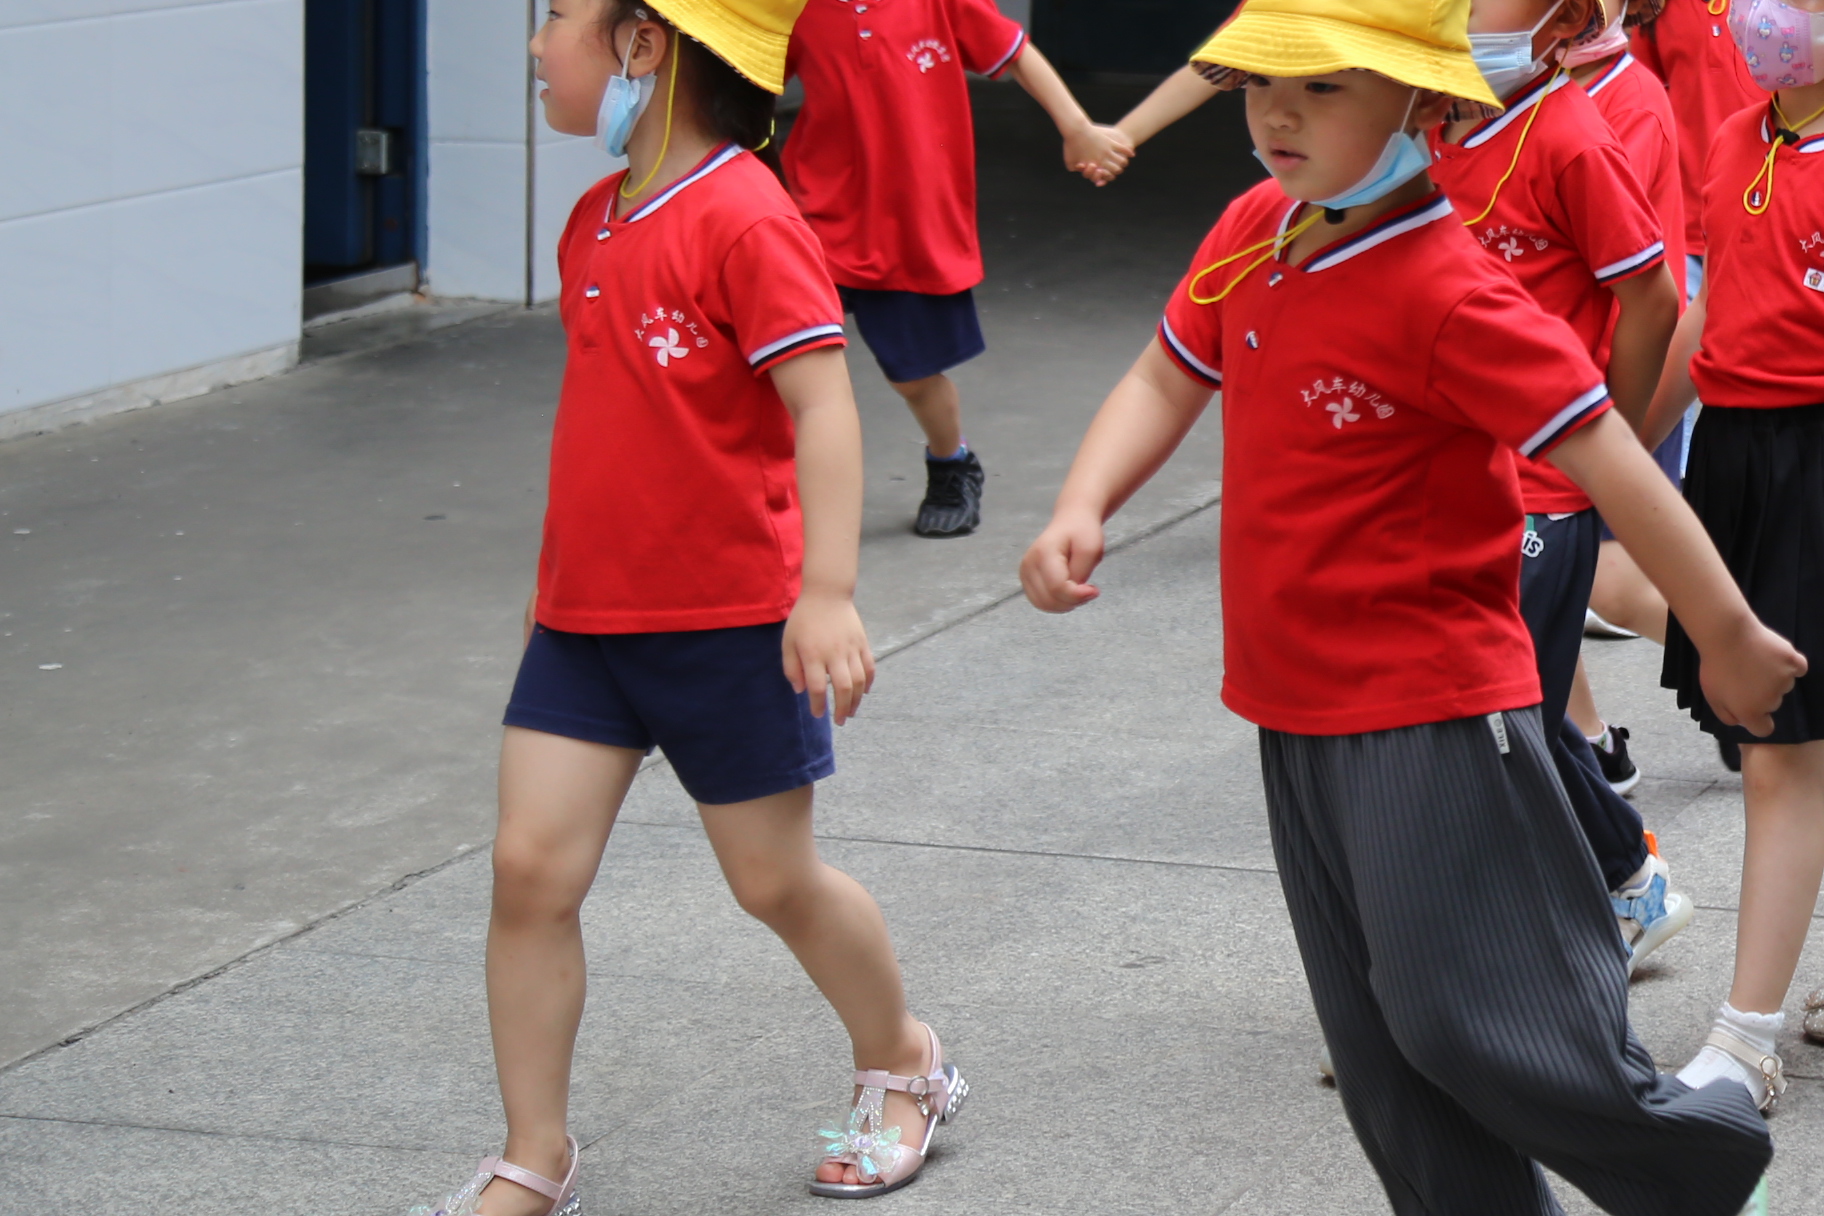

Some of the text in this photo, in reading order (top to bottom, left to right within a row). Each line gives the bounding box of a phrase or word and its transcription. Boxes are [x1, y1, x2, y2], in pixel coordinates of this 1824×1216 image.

[1300, 376, 1395, 419] 大风车幼儿园
